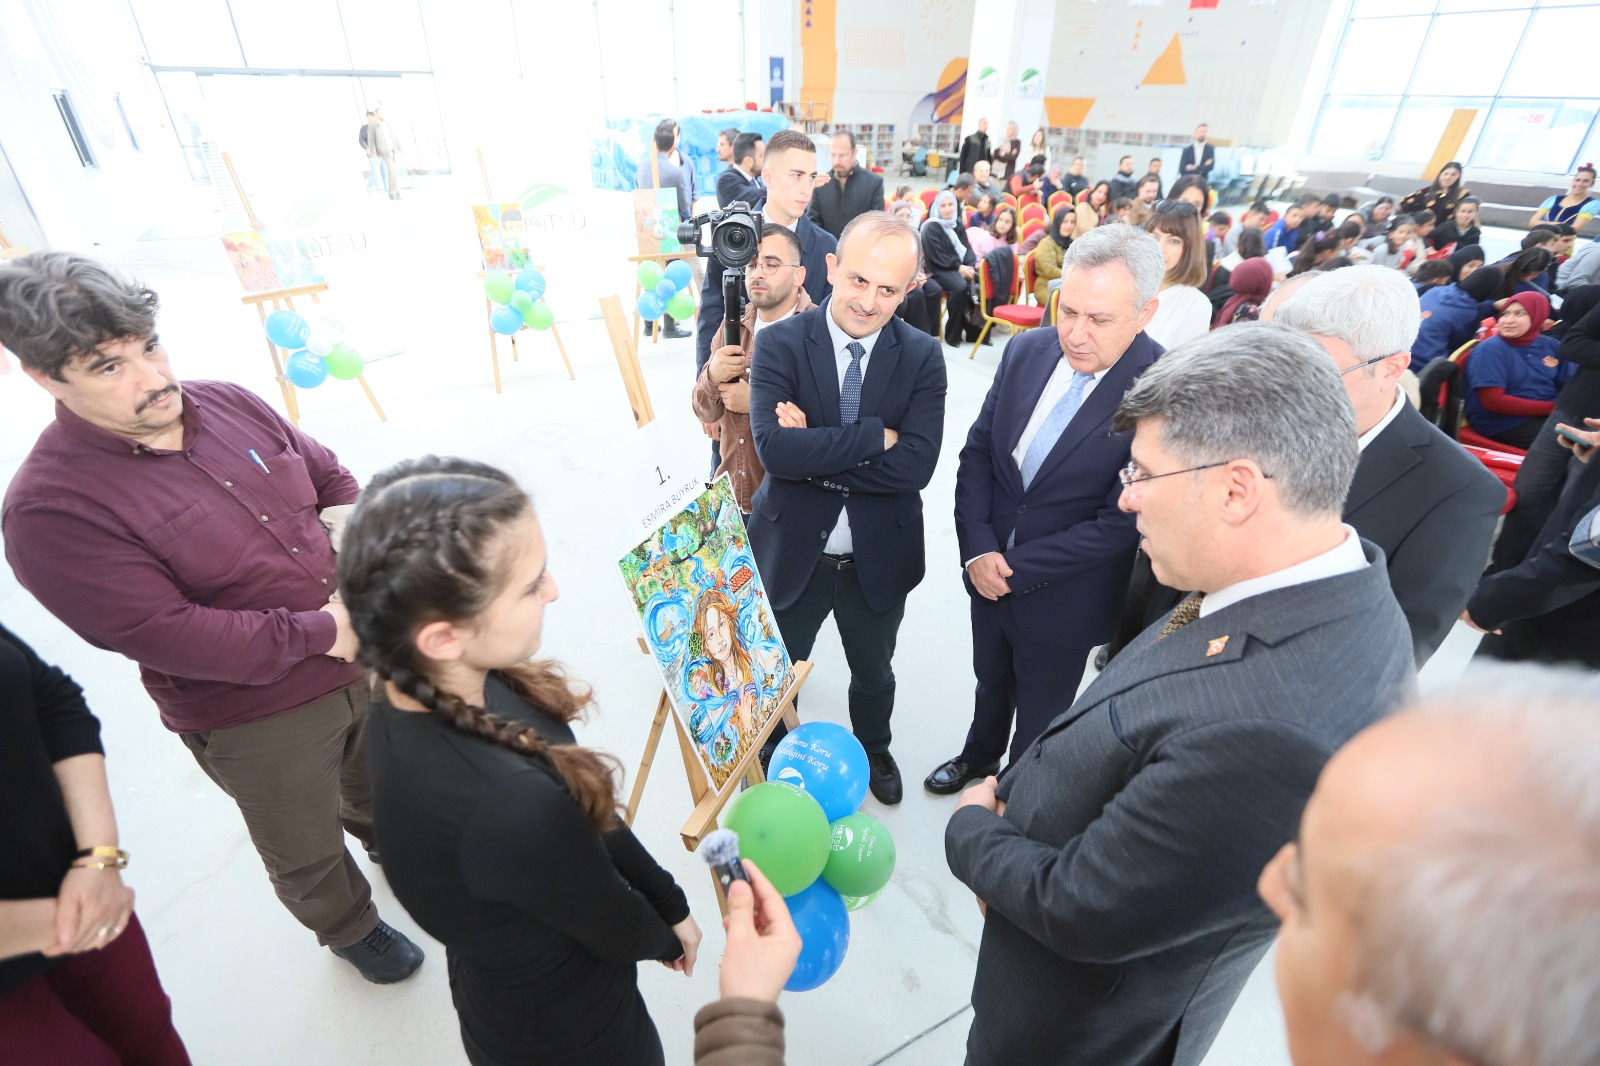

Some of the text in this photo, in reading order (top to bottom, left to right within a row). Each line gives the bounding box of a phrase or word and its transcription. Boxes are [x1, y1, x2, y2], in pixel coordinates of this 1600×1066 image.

[653, 465, 671, 486] 1.
[810, 743, 832, 758] Koru
[806, 755, 829, 771] Koru
